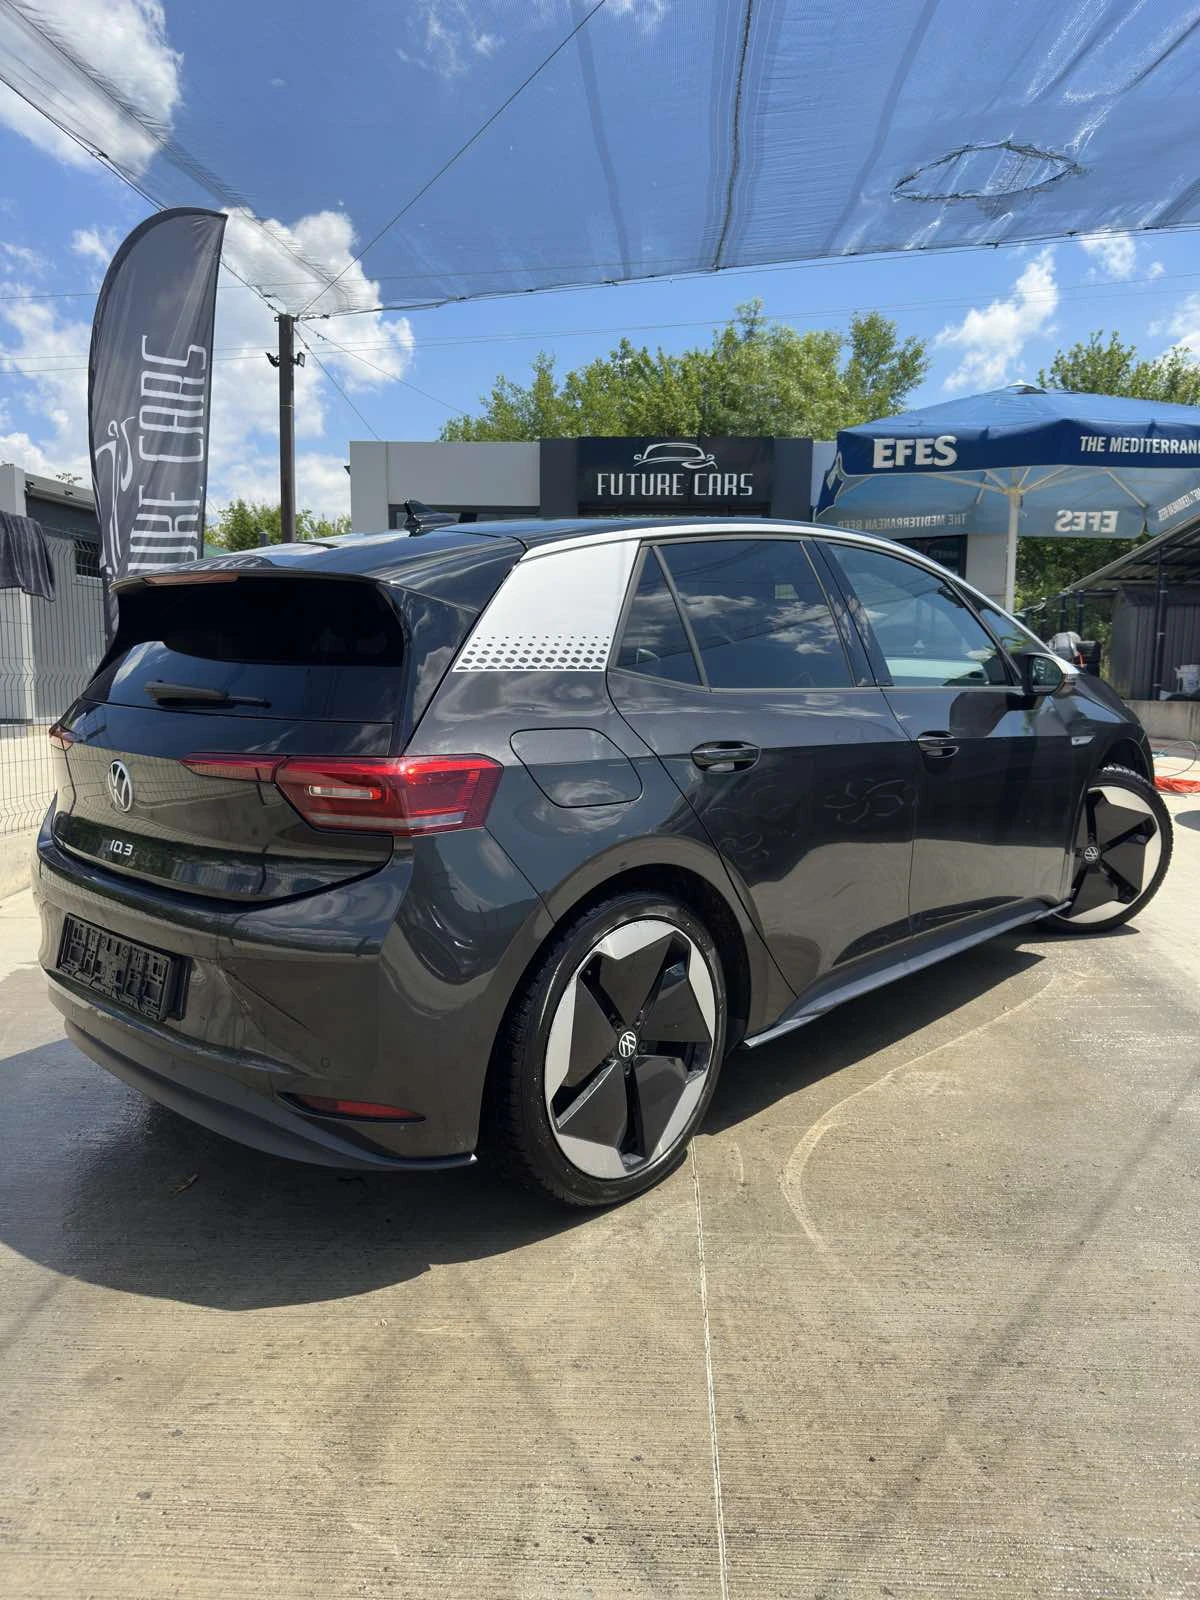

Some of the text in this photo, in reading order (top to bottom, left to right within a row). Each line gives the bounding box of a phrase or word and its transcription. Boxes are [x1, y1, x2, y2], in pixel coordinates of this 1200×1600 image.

[139, 335, 207, 464] CARS
[872, 435, 958, 469] EFES
[1079, 436, 1200, 455] THE MEDITERRAN
[596, 473, 754, 496] FUTURE CARS
